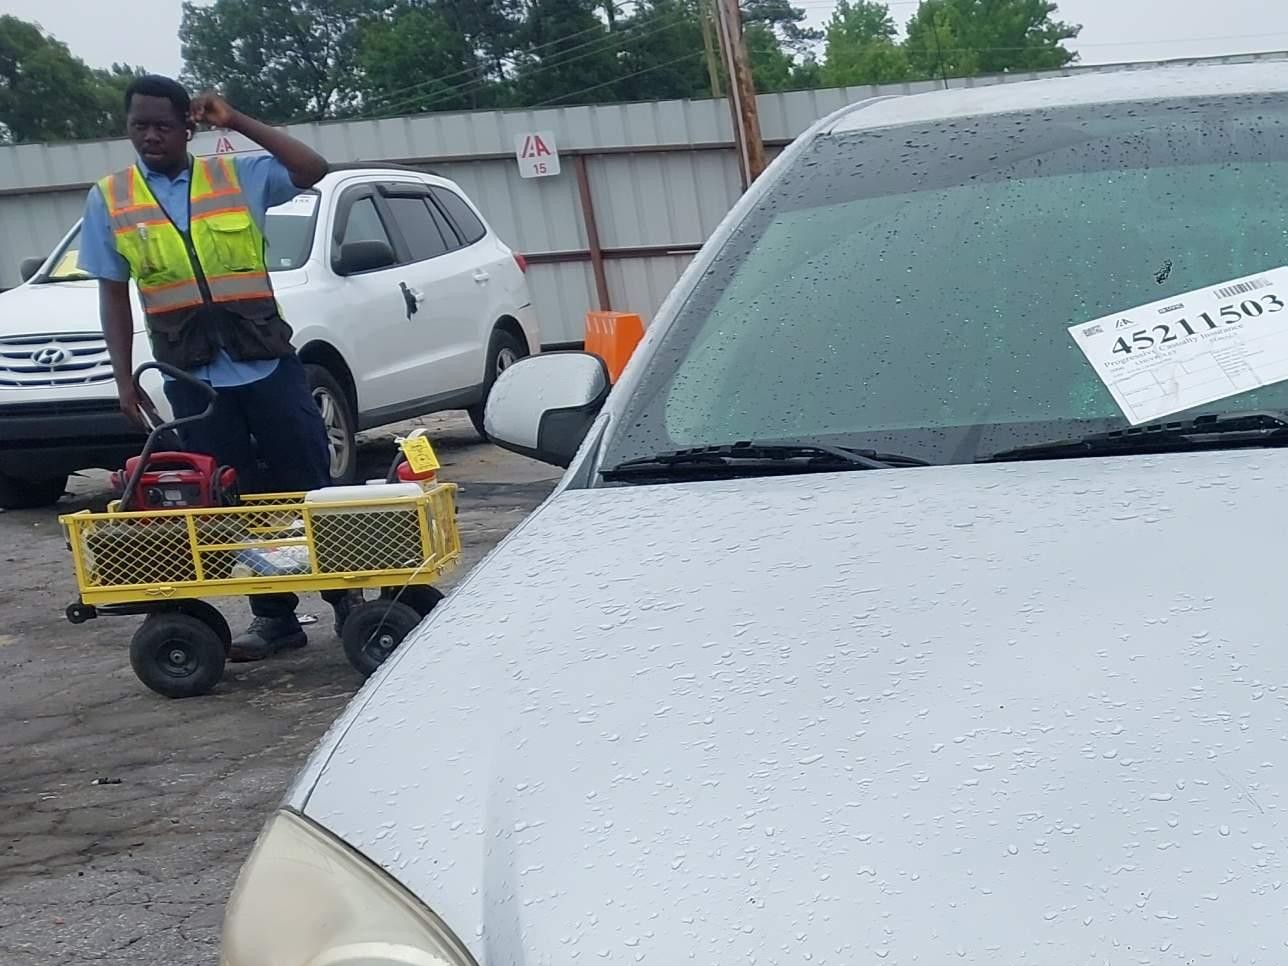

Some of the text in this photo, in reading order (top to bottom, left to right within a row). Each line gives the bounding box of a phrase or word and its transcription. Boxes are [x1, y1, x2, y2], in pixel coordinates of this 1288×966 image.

[533, 163, 547, 175] 15
[1112, 294, 1285, 355] 45211503
[1157, 336, 1199, 352] Casualty
